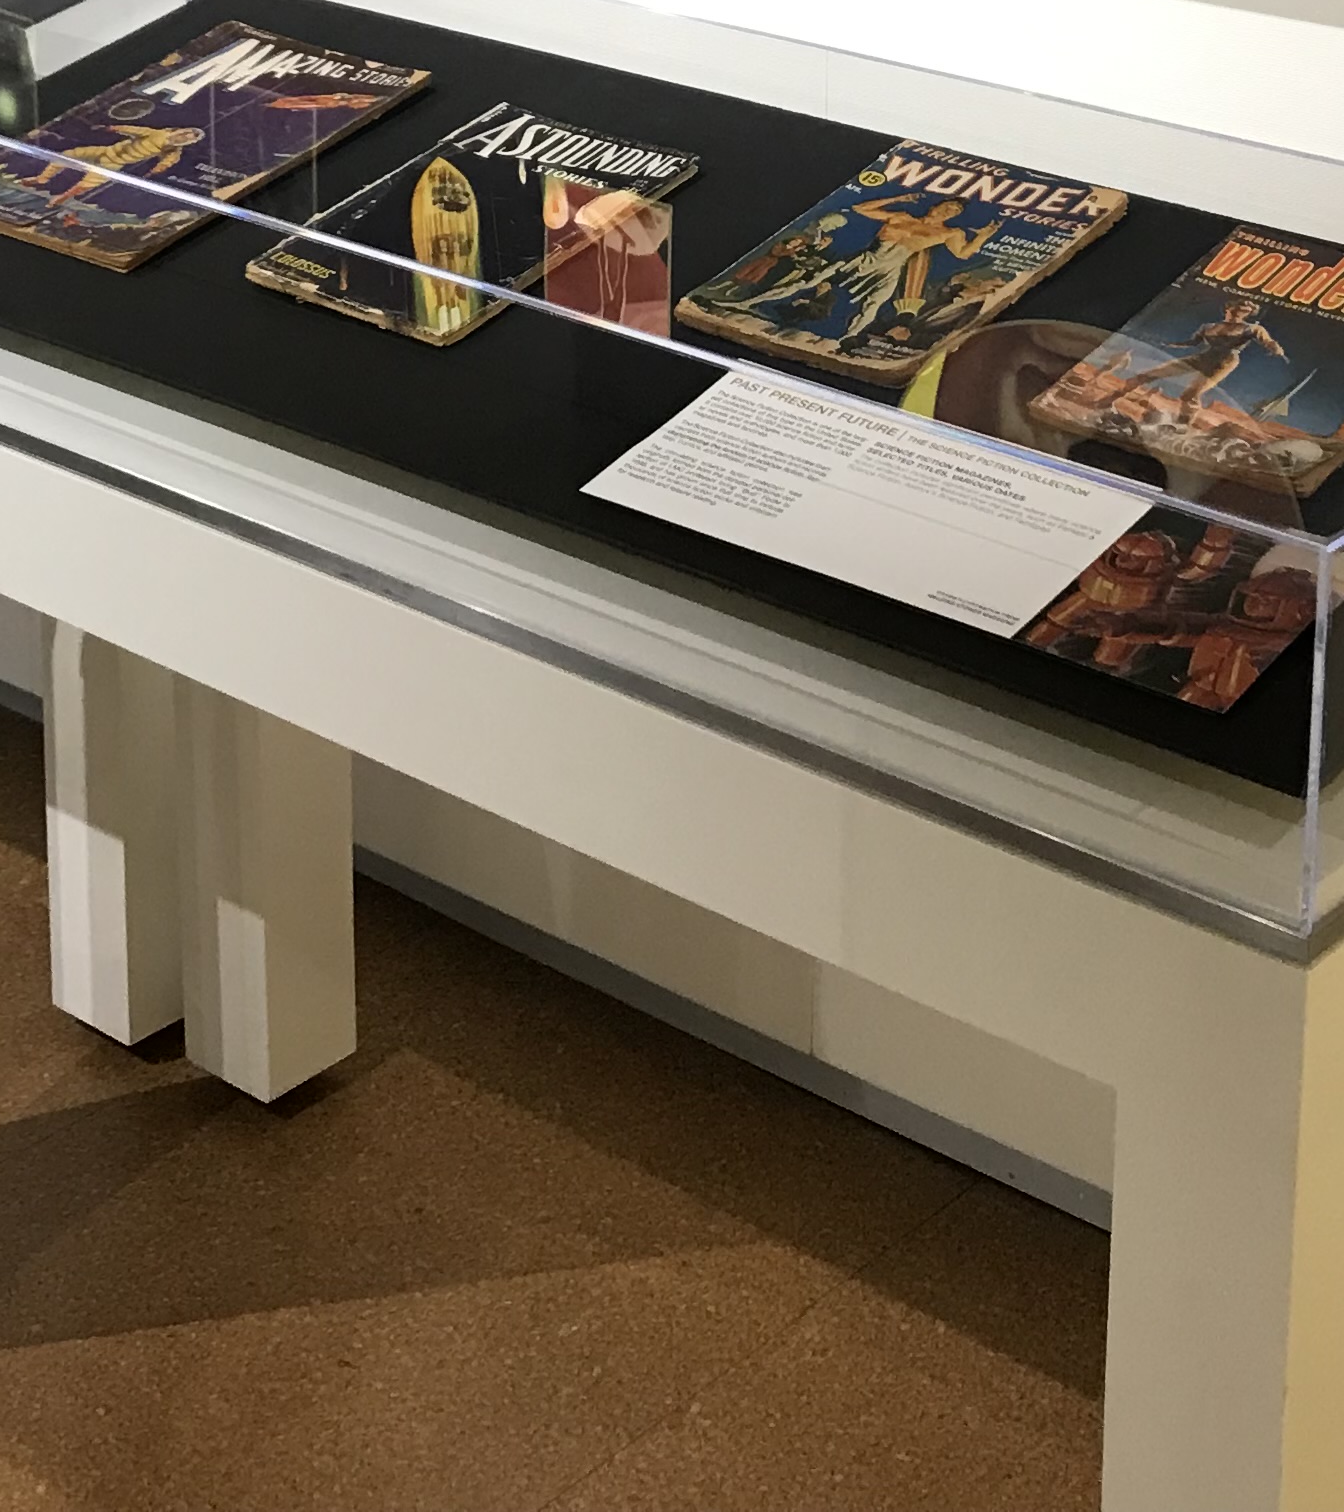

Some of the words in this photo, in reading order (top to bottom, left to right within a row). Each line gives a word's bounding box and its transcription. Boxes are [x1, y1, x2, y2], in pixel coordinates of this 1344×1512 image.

[141, 37, 354, 105] AMAZING
[453, 112, 687, 179] ASTOUNDING
[902, 139, 1010, 177] THRILLING
[531, 165, 609, 190] STORIES
[882, 155, 1110, 218] WONDER
[999, 208, 1089, 233] STORIES
[270, 250, 337, 279] COLOSSUS
[727, 377, 770, 394] PAST
[765, 389, 840, 416] PRESENT
[834, 411, 901, 436] FUTURE
[1017, 470, 1092, 497] COLLECTION
[872, 441, 916, 457] SCIENCE
[913, 454, 954, 469] FICTION
[864, 447, 916, 465] SELECTED
[949, 473, 995, 491] VARIOUS
[992, 487, 1028, 501] DATES
